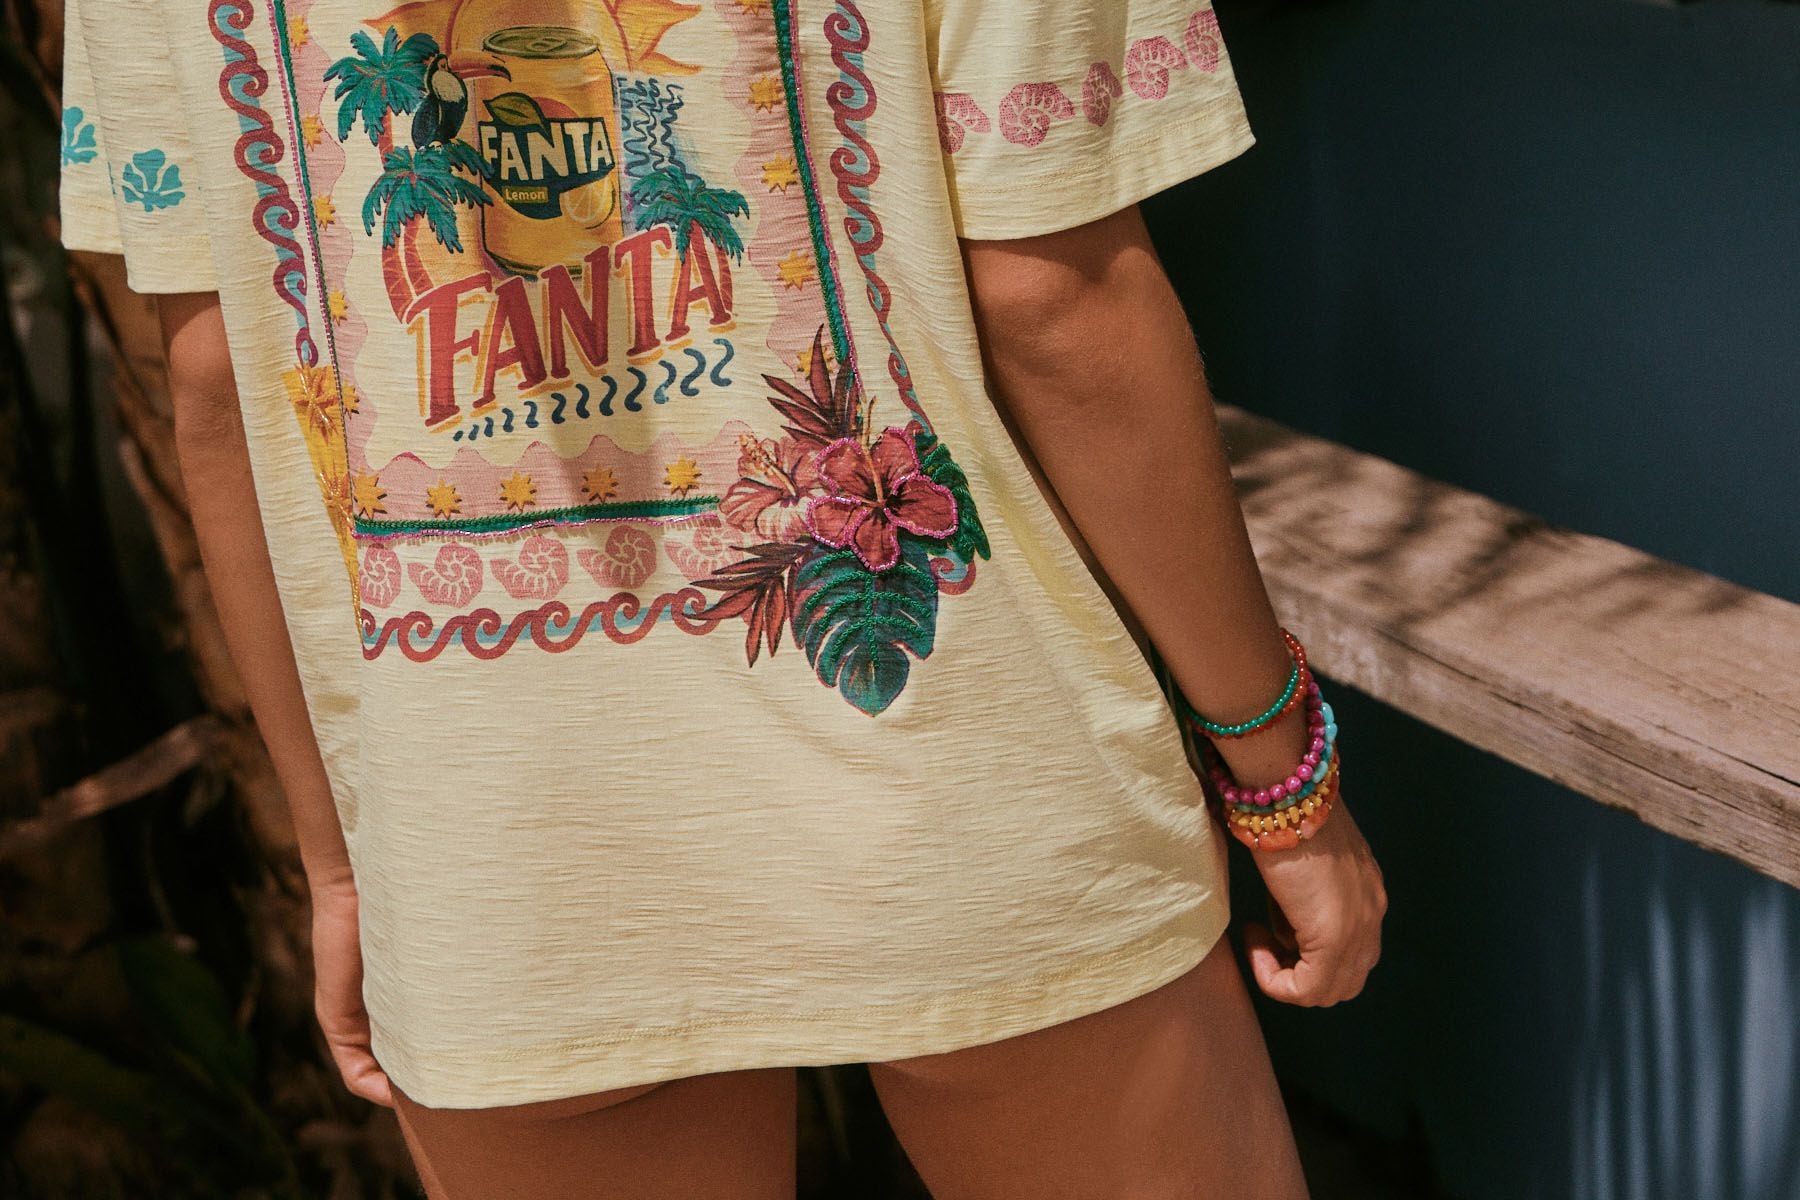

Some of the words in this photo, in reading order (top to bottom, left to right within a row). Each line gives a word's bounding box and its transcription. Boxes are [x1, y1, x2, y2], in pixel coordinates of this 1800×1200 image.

[480, 121, 613, 181] FANTA
[505, 187, 546, 202] Lemon
[406, 221, 734, 428] FANTA
